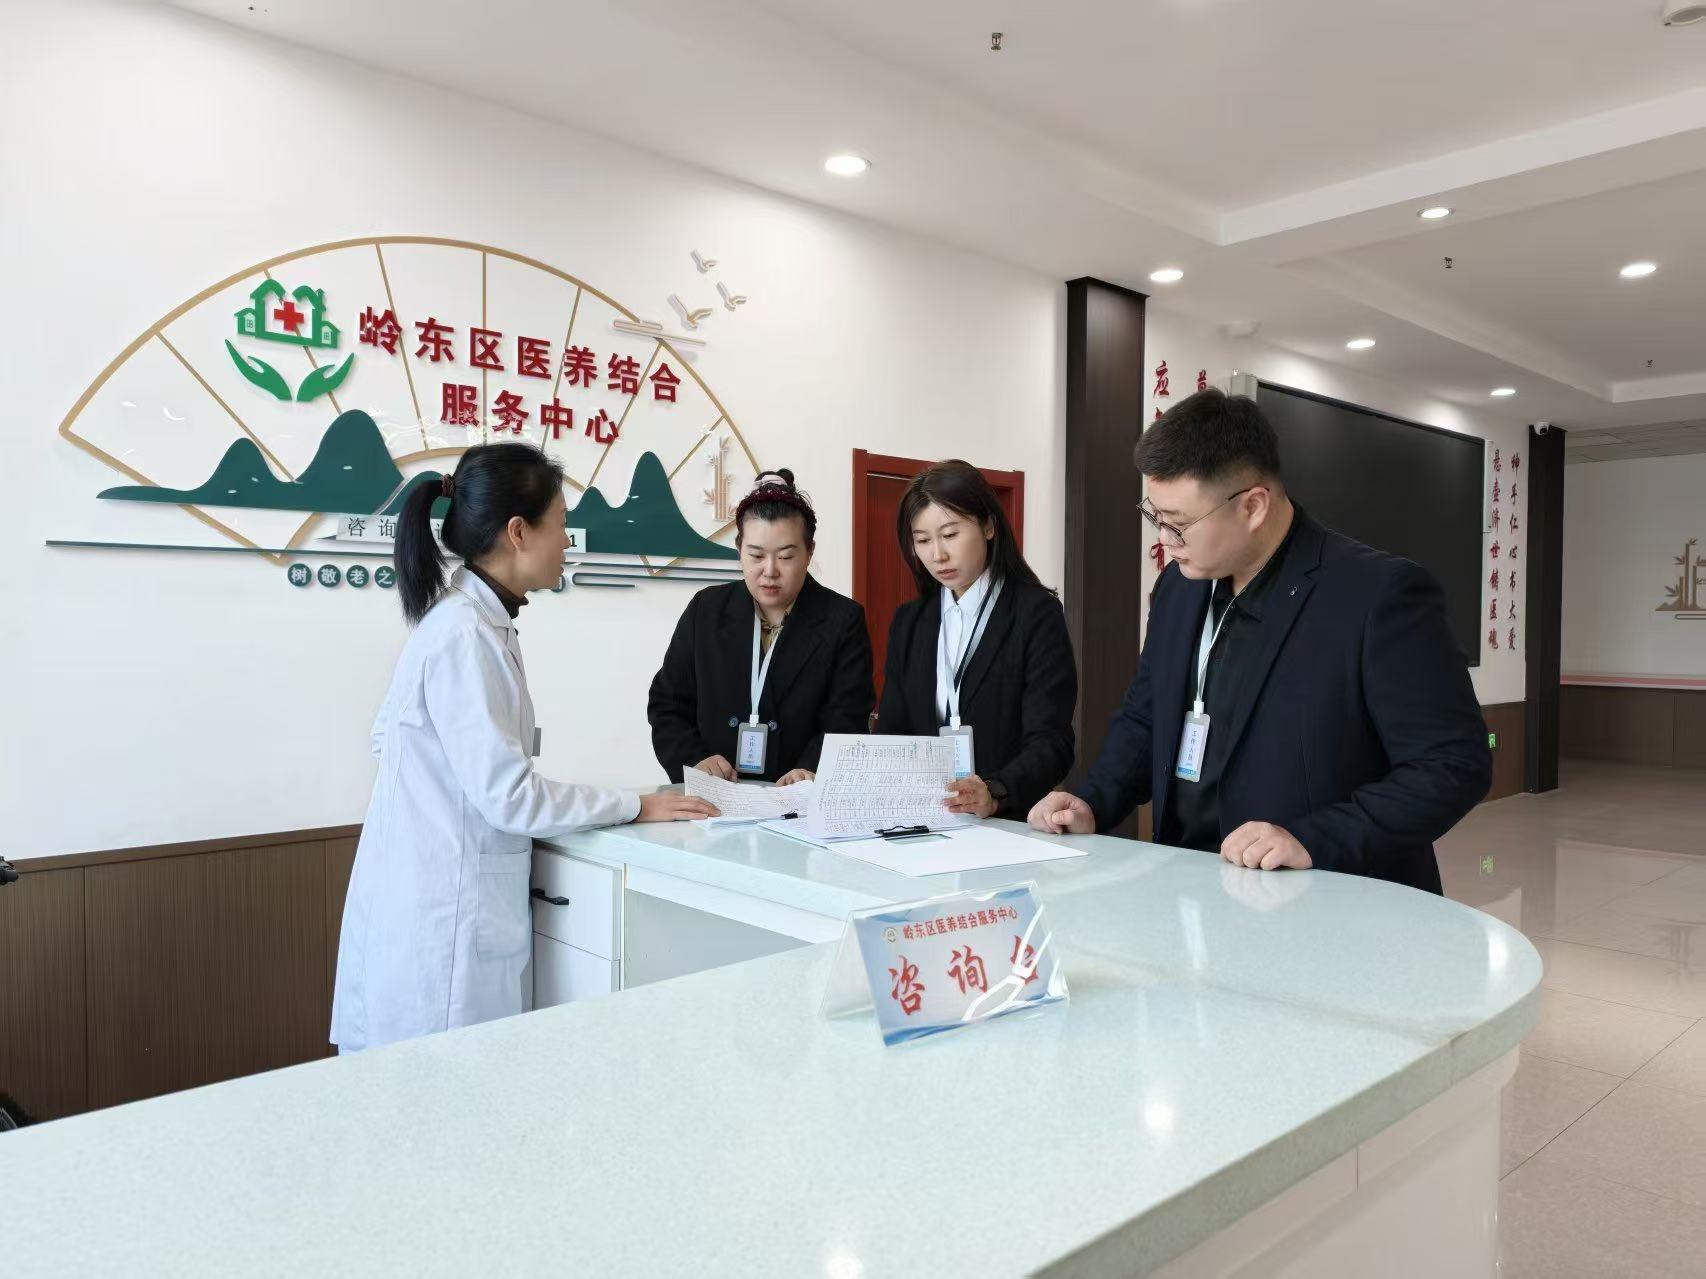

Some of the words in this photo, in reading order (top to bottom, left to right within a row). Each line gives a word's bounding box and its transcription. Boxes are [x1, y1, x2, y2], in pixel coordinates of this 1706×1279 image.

[358, 305, 682, 404] 岭东区医养结合
[439, 382, 620, 445] 服务中心
[290, 565, 395, 586] 树敬老之
[902, 904, 1019, 940] 岭东区医养结合服务中心
